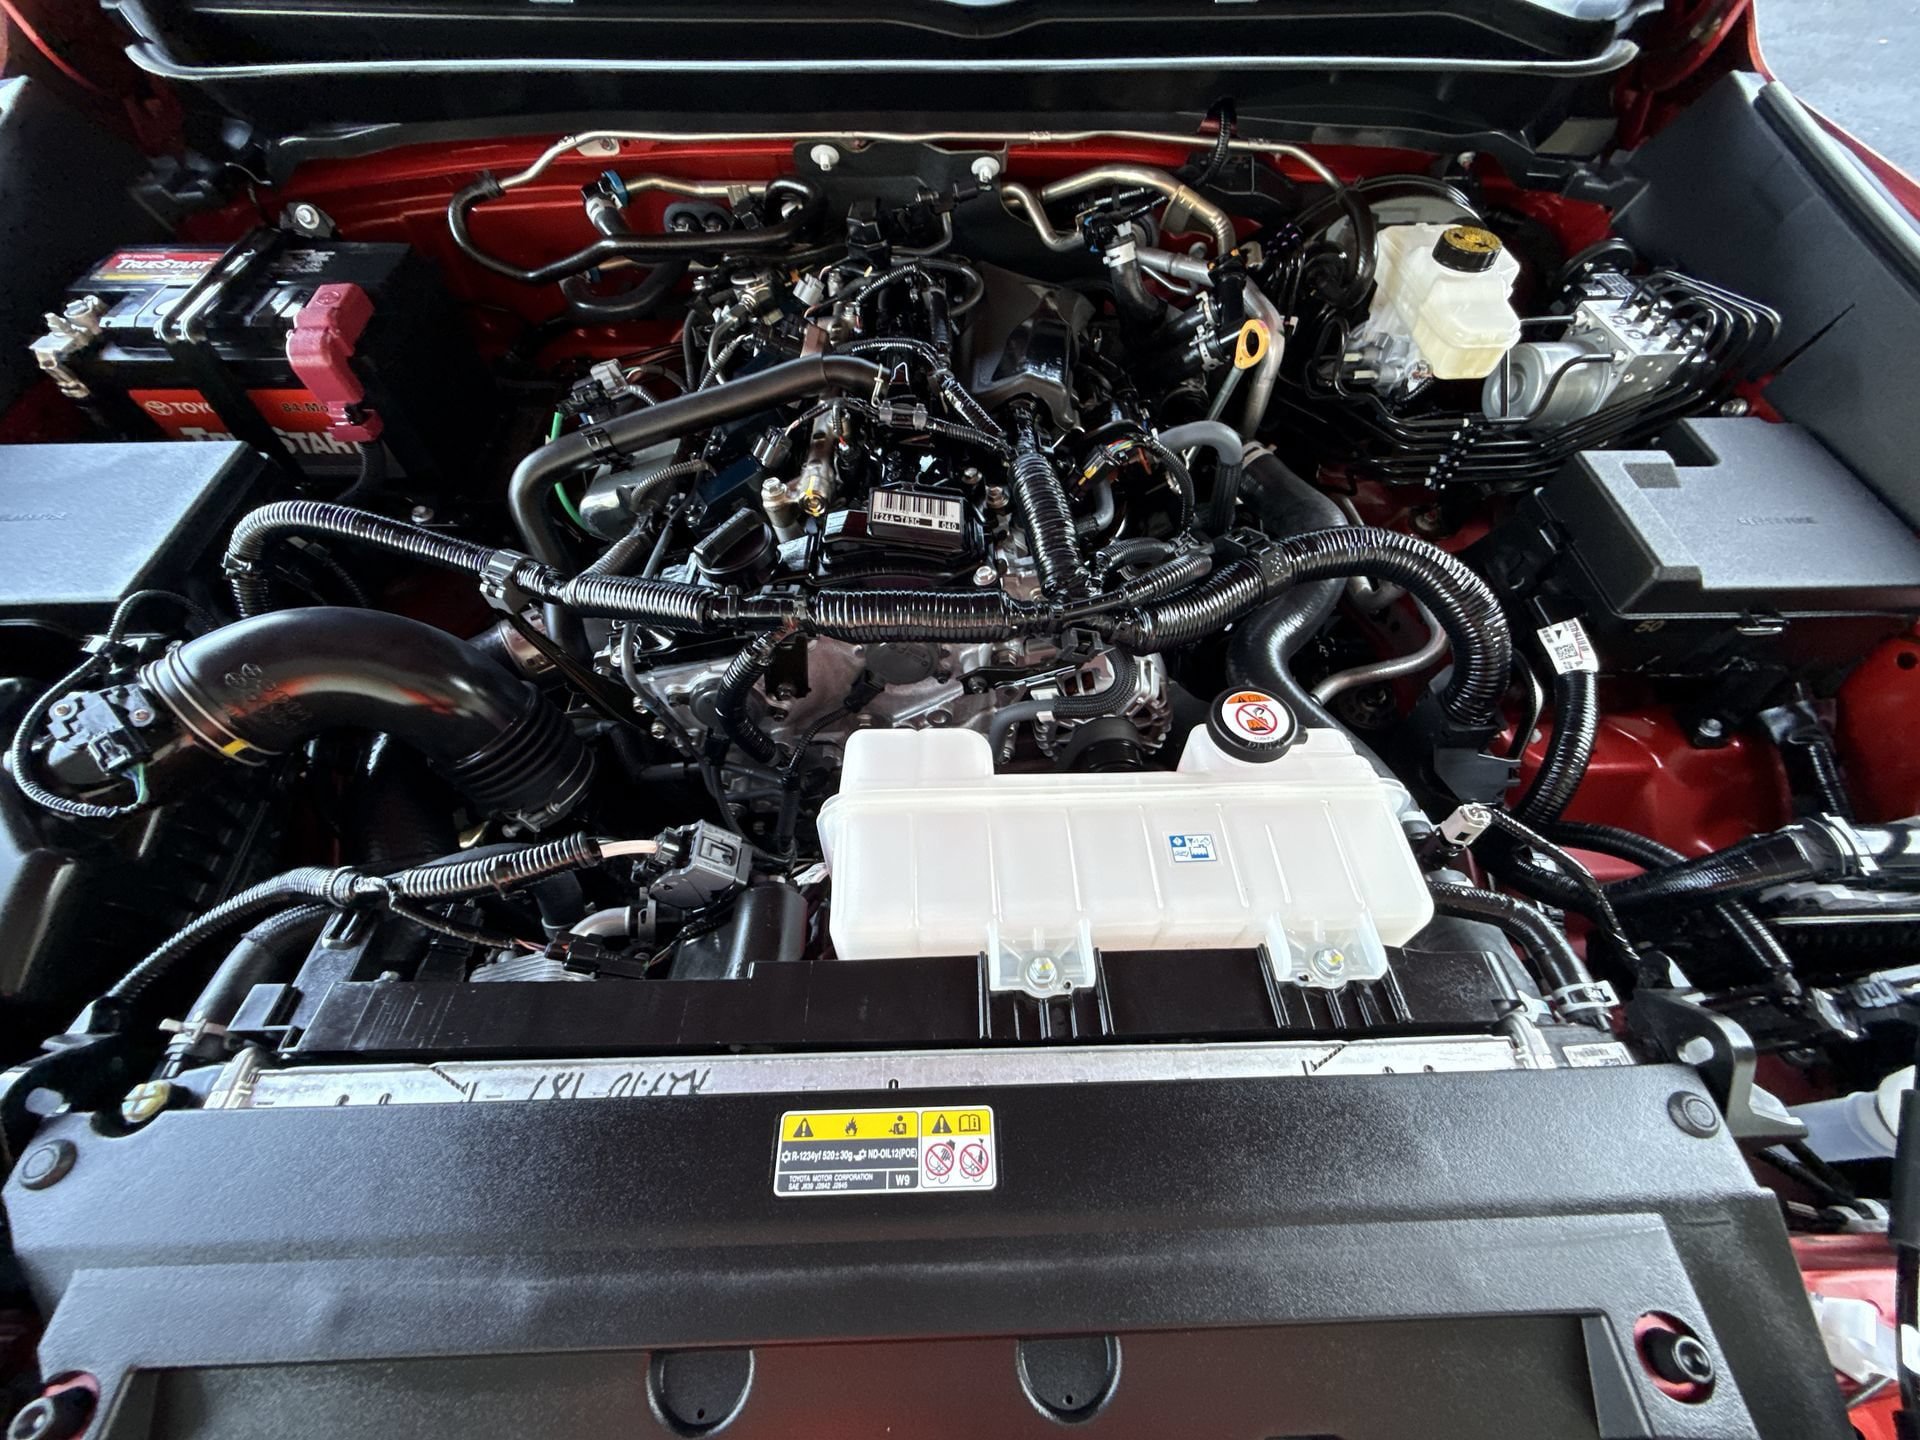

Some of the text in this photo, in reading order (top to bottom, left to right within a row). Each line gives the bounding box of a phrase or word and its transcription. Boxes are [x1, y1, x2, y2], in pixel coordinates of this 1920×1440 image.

[791, 1147, 918, 1163] R-1234yf 520±30g ND-OIL12(POE)
[789, 1173, 873, 1183] TOYOTA MOTOR CORPORATION
[895, 1176, 910, 1186] W9
[788, 1183, 799, 1191] SAE
